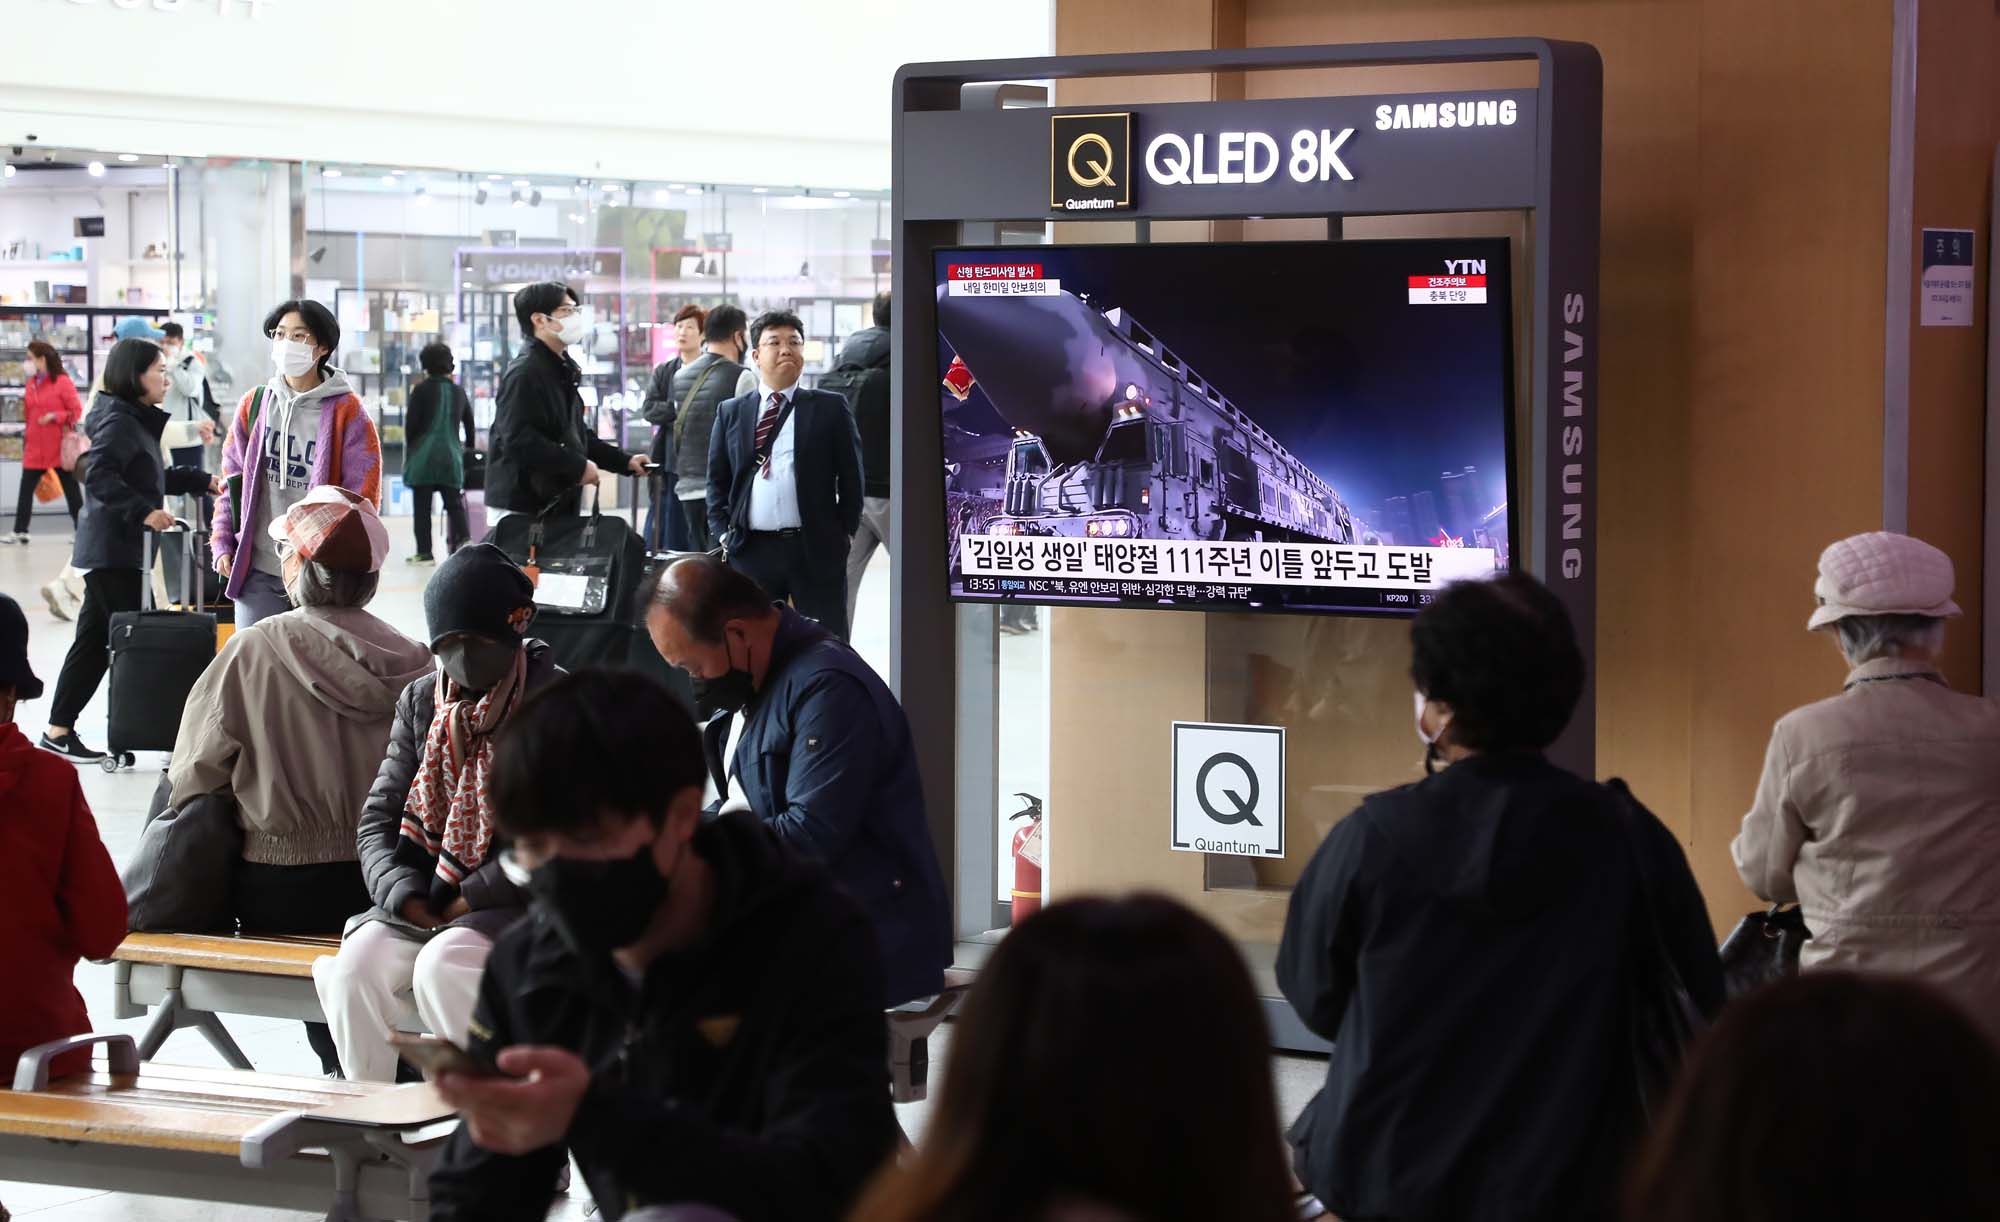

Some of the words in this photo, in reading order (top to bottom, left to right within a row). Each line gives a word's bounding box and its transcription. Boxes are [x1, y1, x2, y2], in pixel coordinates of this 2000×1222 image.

[1375, 100, 1517, 130] SAMSUNG
[1067, 133, 1117, 188] Q
[1145, 131, 1280, 186] QLED
[1288, 128, 1357, 183] 8K
[1065, 198, 1115, 210] Quantum
[957, 266, 973, 278] 신형
[974, 266, 1016, 278] 탄도미사일
[1017, 266, 1034, 278] 발사
[1444, 259, 1487, 275] YTN
[963, 281, 981, 294] 내일
[982, 281, 1009, 294] 한미일
[1010, 281, 1046, 294] 안보회의
[1428, 277, 1467, 288] 건조주의보
[1429, 290, 1447, 302] 충북
[1448, 290, 1467, 302] 단양
[1562, 293, 1584, 579] SAMSUNG
[968, 538, 1035, 571] '김일성
[1041, 541, 1087, 572] 생일'
[1094, 543, 1159, 575] 태양절
[1165, 546, 1252, 577] 111주년
[1259, 548, 1304, 579] 이틀
[1311, 549, 1380, 581] 앞두고
[1386, 551, 1433, 583] 도발
[969, 578, 996, 590] 13:55
[1000, 579, 1026, 591] 통일외교
[1028, 580, 1049, 592] NSC
[1068, 580, 1088, 594] 유엔
[1089, 581, 1119, 595] 안보리
[1386, 594, 1409, 603] KP200
[1196, 751, 1264, 827] Q
[1194, 837, 1261, 855] Quantum
